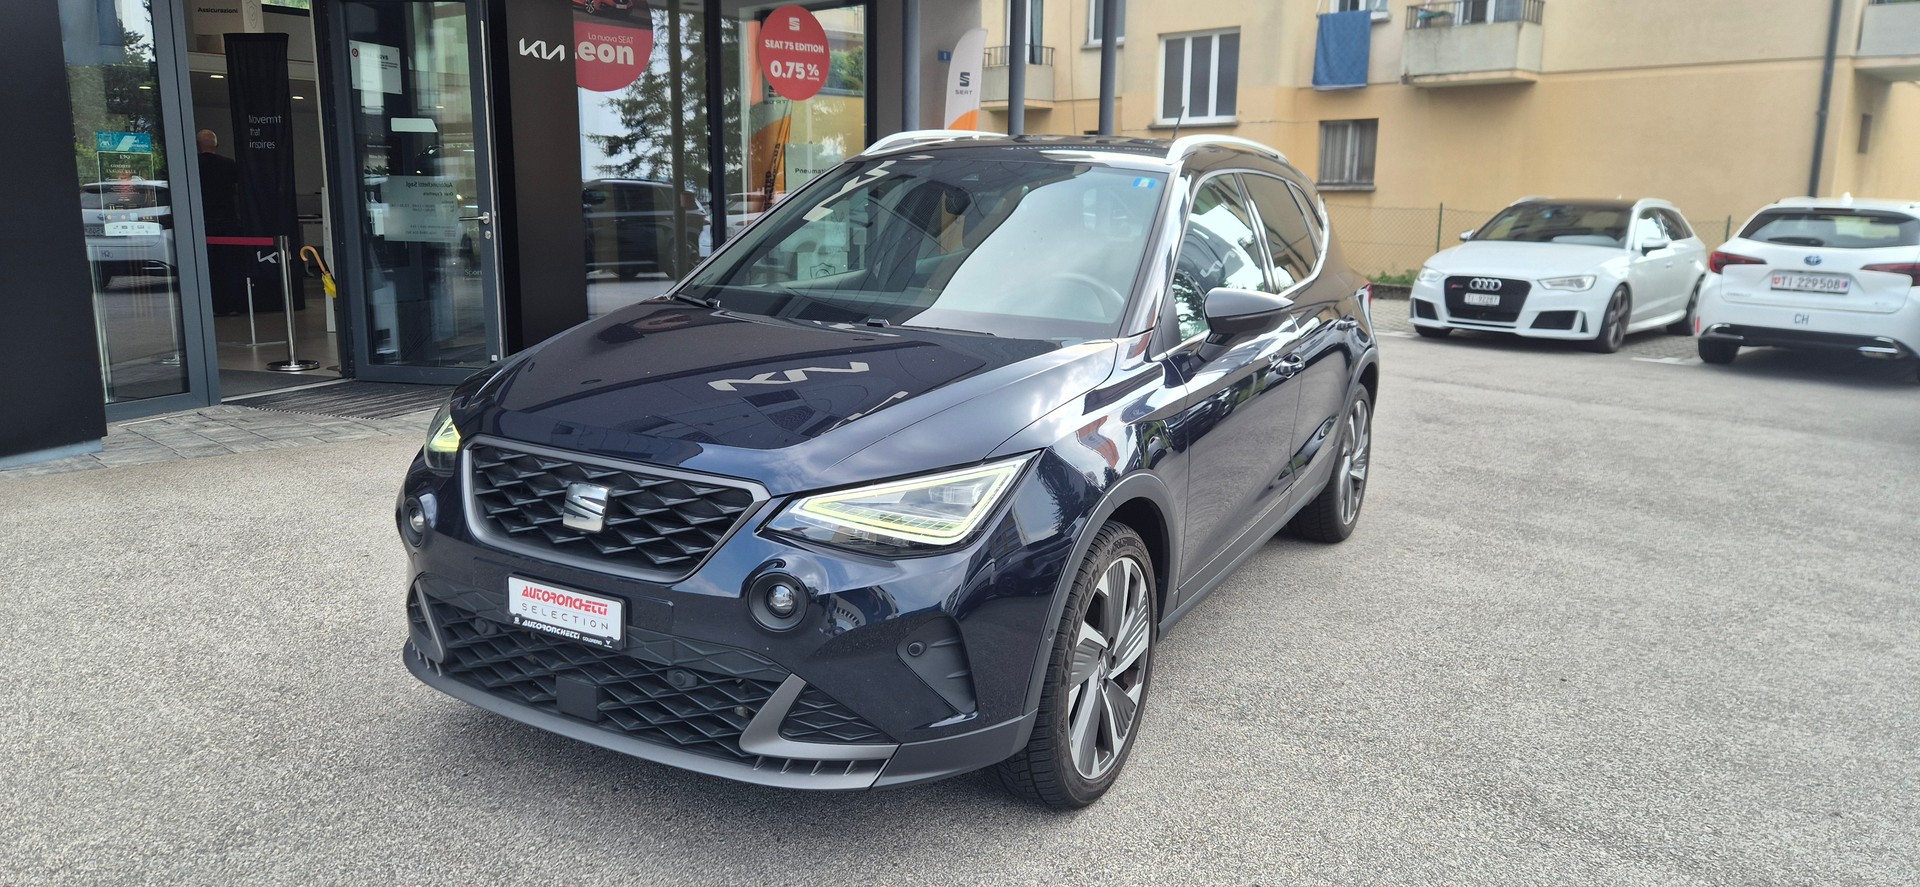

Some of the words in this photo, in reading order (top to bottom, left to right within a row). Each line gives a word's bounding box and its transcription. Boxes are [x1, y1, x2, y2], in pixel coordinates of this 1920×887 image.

[588, 32, 597, 40] La
[597, 35, 617, 43] nuova
[618, 35, 634, 43] SEAT
[764, 39, 784, 49] SEAT
[785, 41, 794, 50] 75
[795, 42, 824, 53] EDITION
[574, 41, 635, 66] eon
[770, 60, 806, 79] 0.75
[806, 63, 820, 76] %
[1781, 276, 1793, 287] TI
[1794, 313, 1810, 325] CH
[521, 585, 608, 616] AUTORONCHETTI
[521, 602, 609, 630] SELECTION
[522, 619, 581, 640] AUTORONCHETTI
